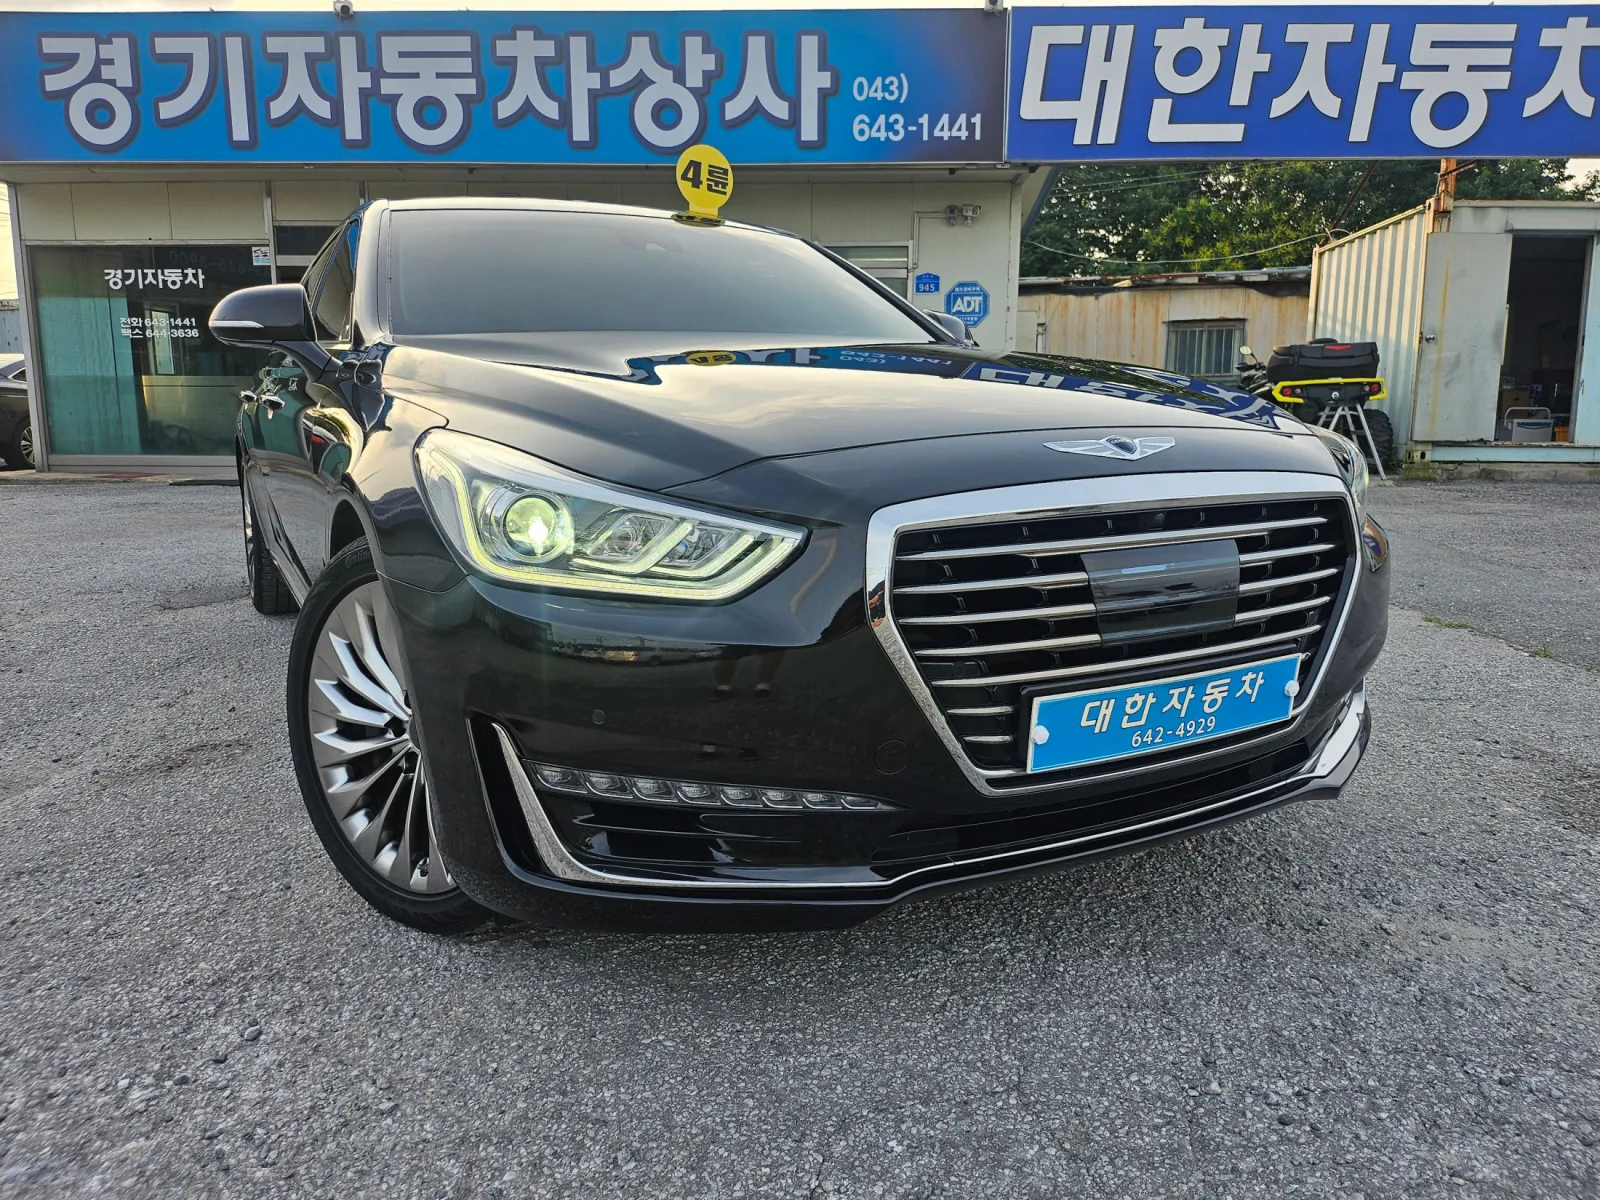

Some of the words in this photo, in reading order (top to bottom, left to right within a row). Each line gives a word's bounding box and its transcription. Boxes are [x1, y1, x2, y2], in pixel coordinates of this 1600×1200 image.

[40, 30, 832, 148] 경기자동차상사
[852, 73, 909, 104] 043)
[852, 113, 982, 142] 643-1441
[104, 268, 205, 290] 경기자동차
[918, 283, 935, 292] 945
[952, 296, 982, 313] ADT
[119, 317, 143, 327] 전화
[144, 317, 196, 327] 643-1441
[120, 328, 143, 338] 팩스
[145, 328, 199, 338] 644-3636
[1131, 715, 1216, 748] 642-4929
